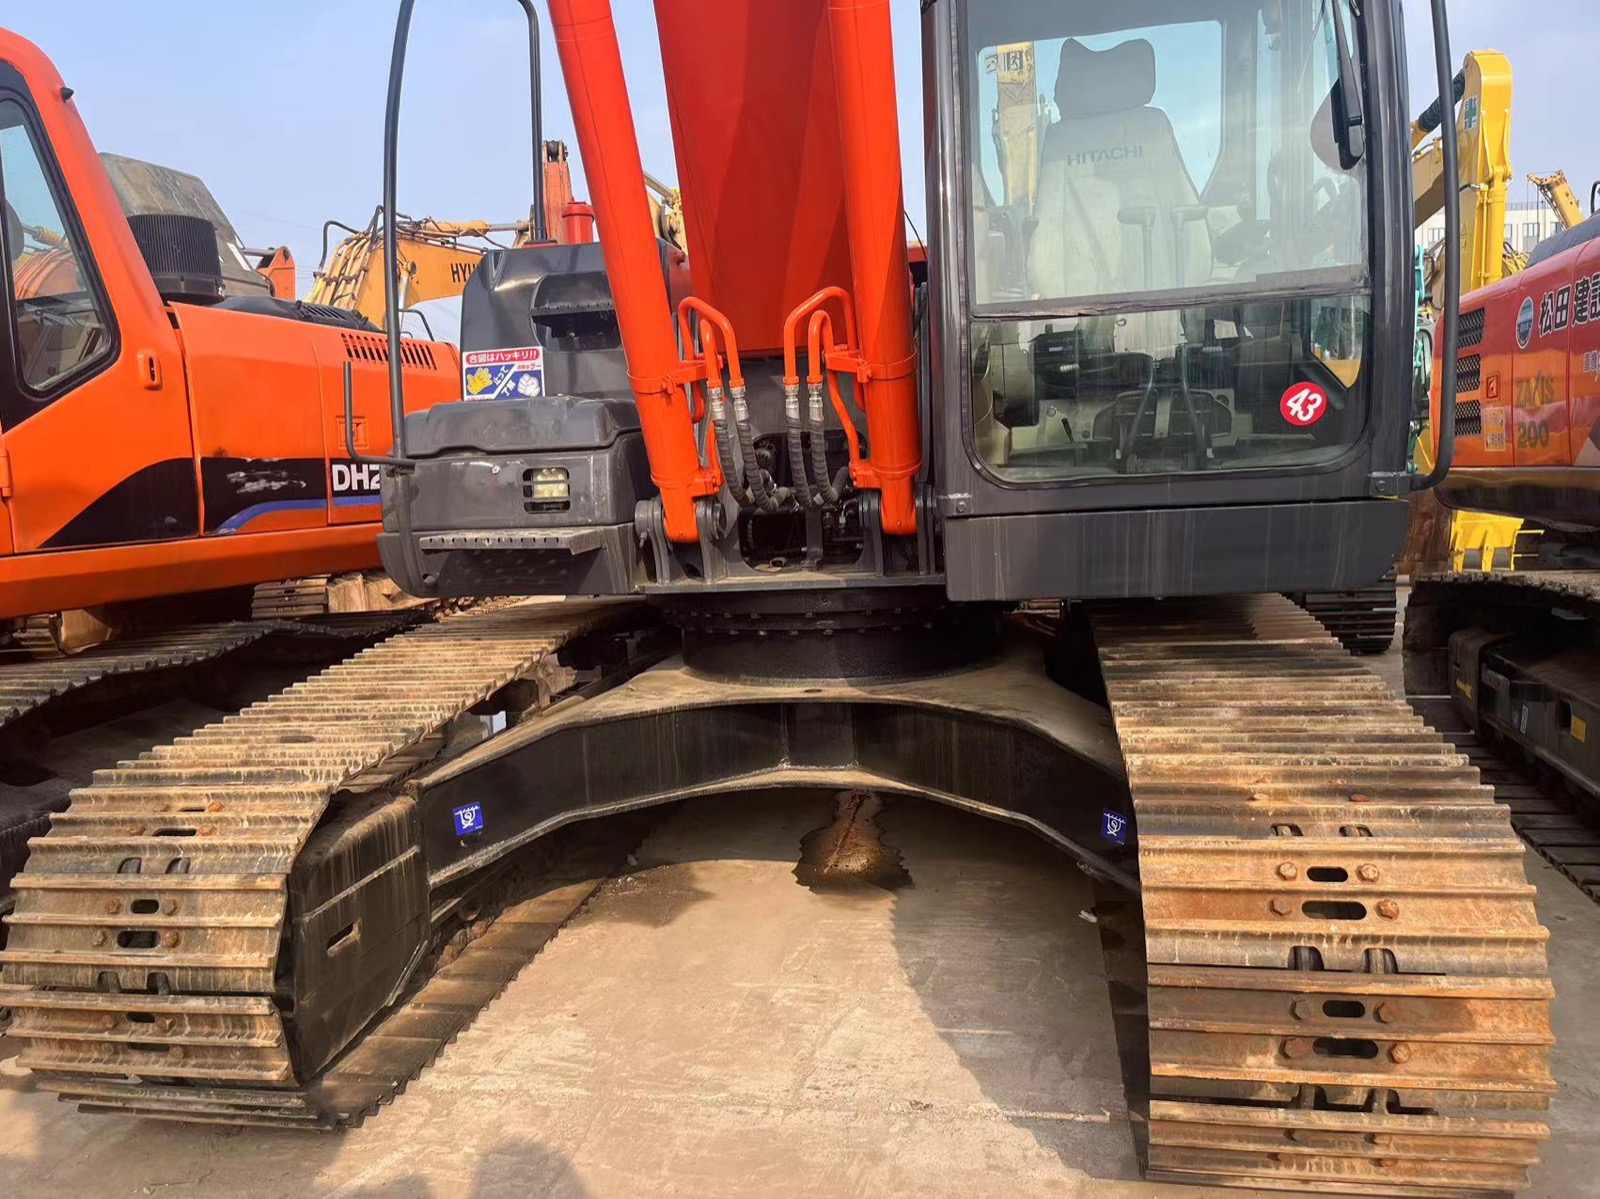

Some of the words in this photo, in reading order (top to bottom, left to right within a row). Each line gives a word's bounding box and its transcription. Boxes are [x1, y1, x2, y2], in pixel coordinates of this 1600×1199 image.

[1067, 144, 1143, 166] HITACHI
[1286, 388, 1322, 421] 43
[1518, 418, 1550, 448] 200
